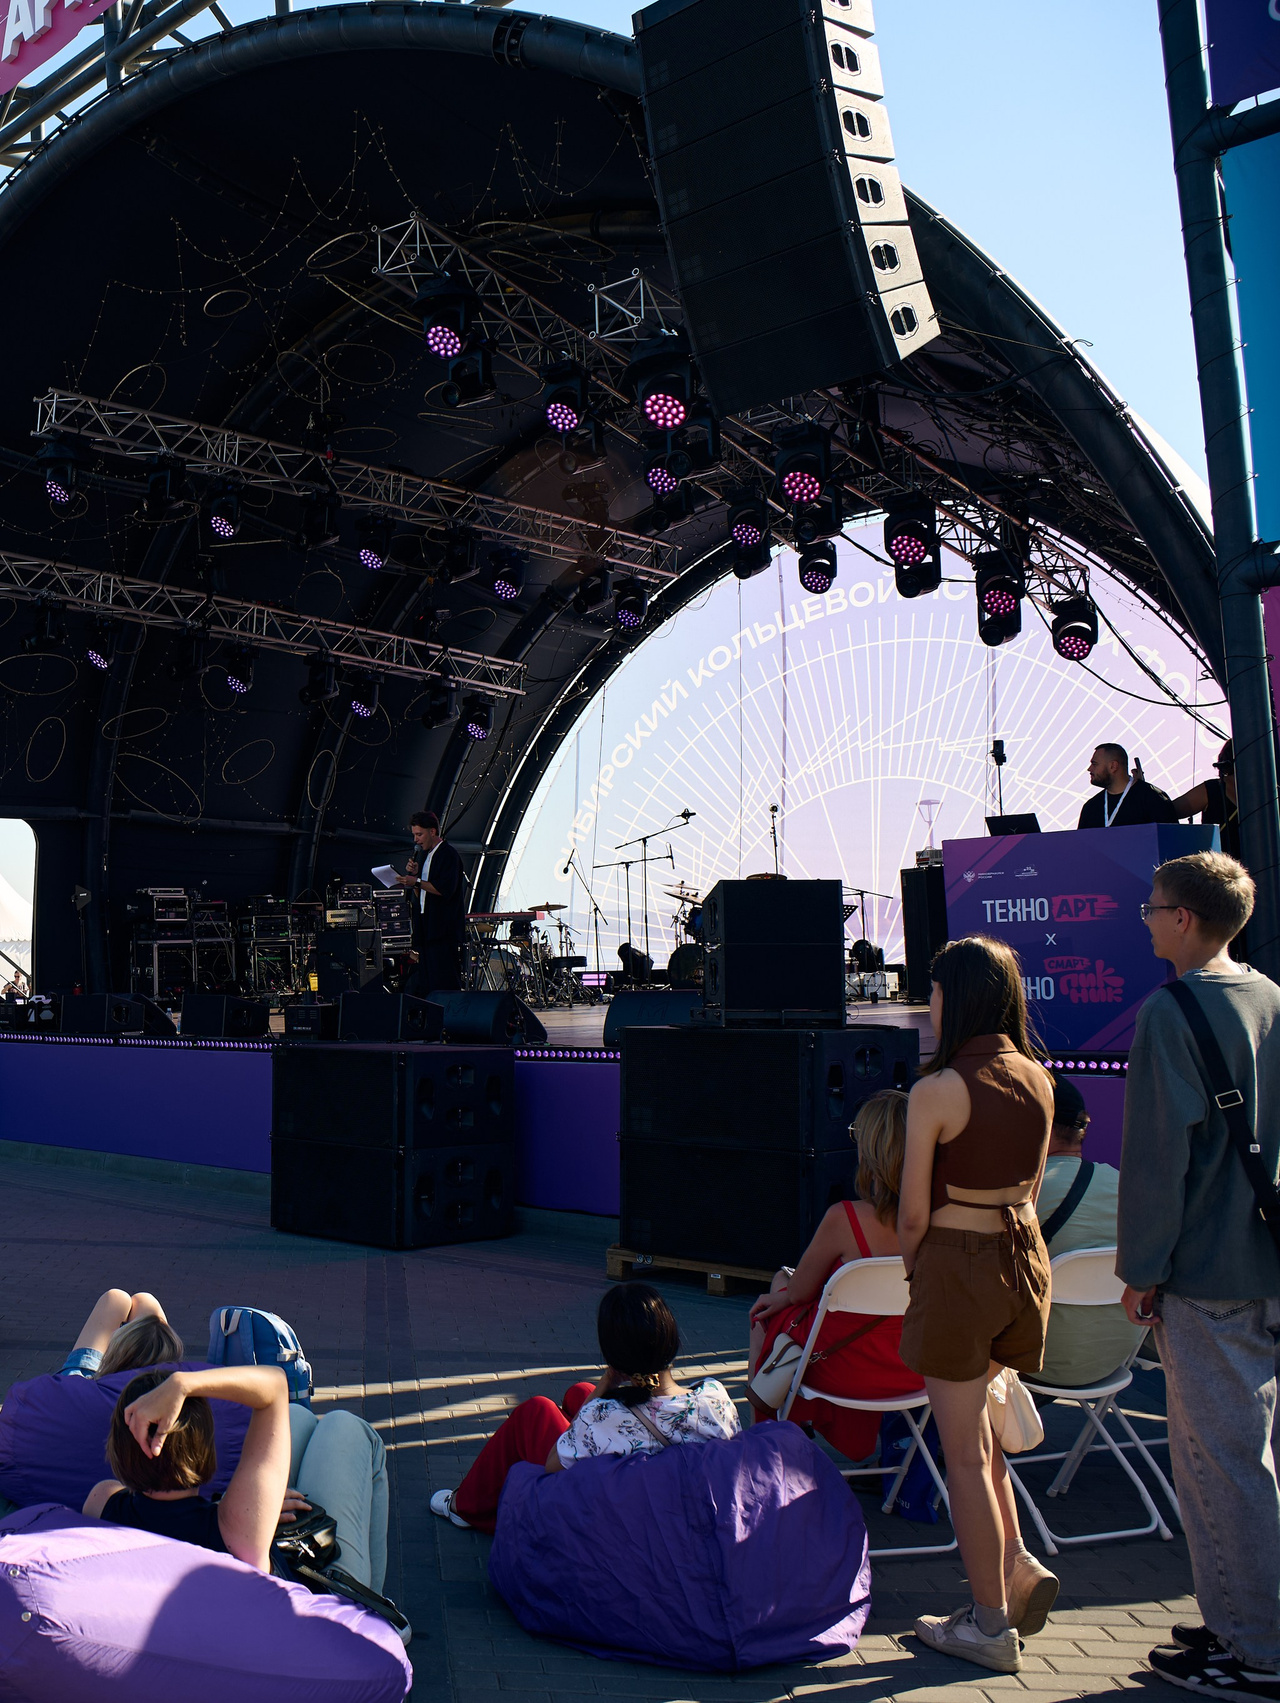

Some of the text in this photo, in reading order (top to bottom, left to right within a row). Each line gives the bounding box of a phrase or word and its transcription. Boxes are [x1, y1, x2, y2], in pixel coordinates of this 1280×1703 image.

[554, 679, 690, 883] СИБИРСКИЙ
[981, 897, 1099, 923] ТЕХНО АРТ
[1047, 958, 1085, 969] СМАРТ
